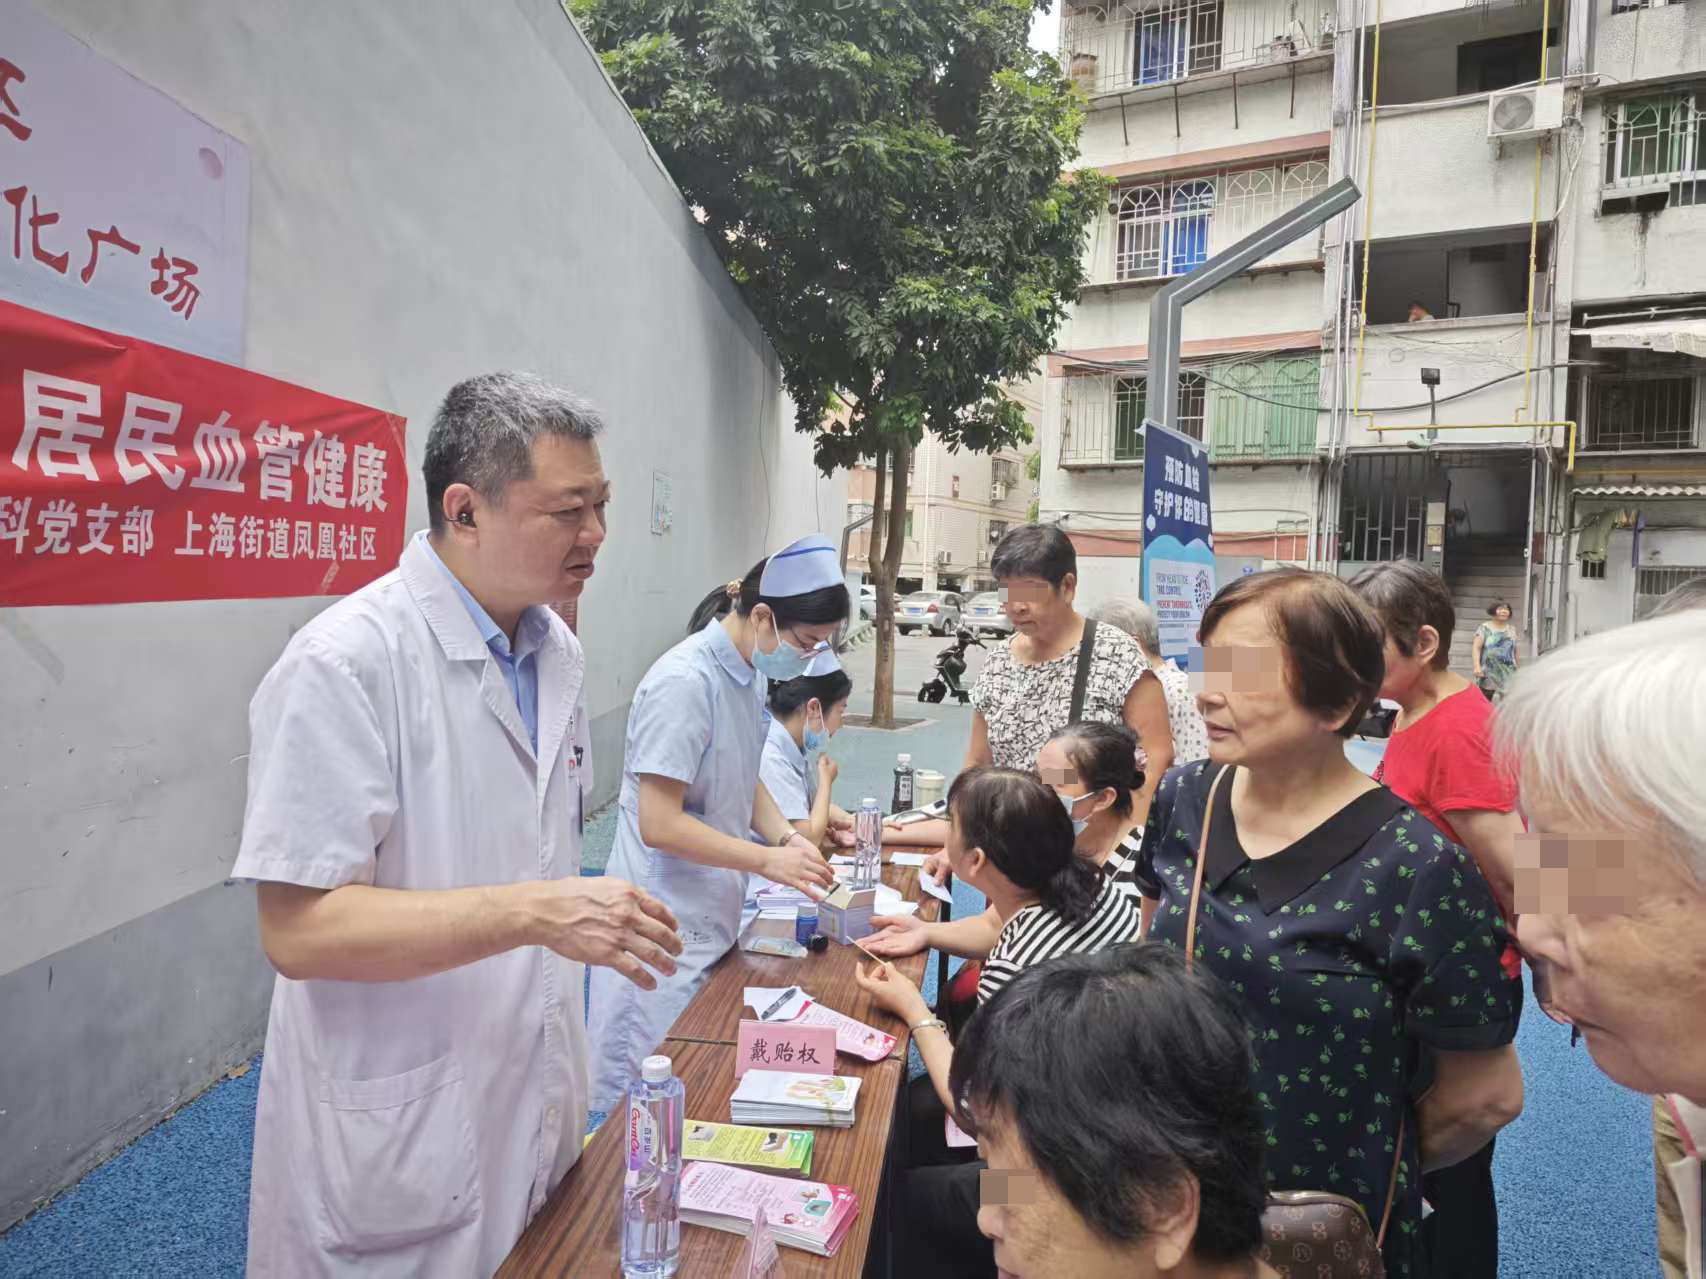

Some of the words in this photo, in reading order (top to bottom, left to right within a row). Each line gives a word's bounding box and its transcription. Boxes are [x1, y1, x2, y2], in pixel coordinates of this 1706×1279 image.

[3, 185, 200, 320] 化广场
[11, 368, 388, 512] 居民血管健康
[0, 496, 154, 557] 科党支部
[174, 510, 377, 561] 上海街道凤凰社区
